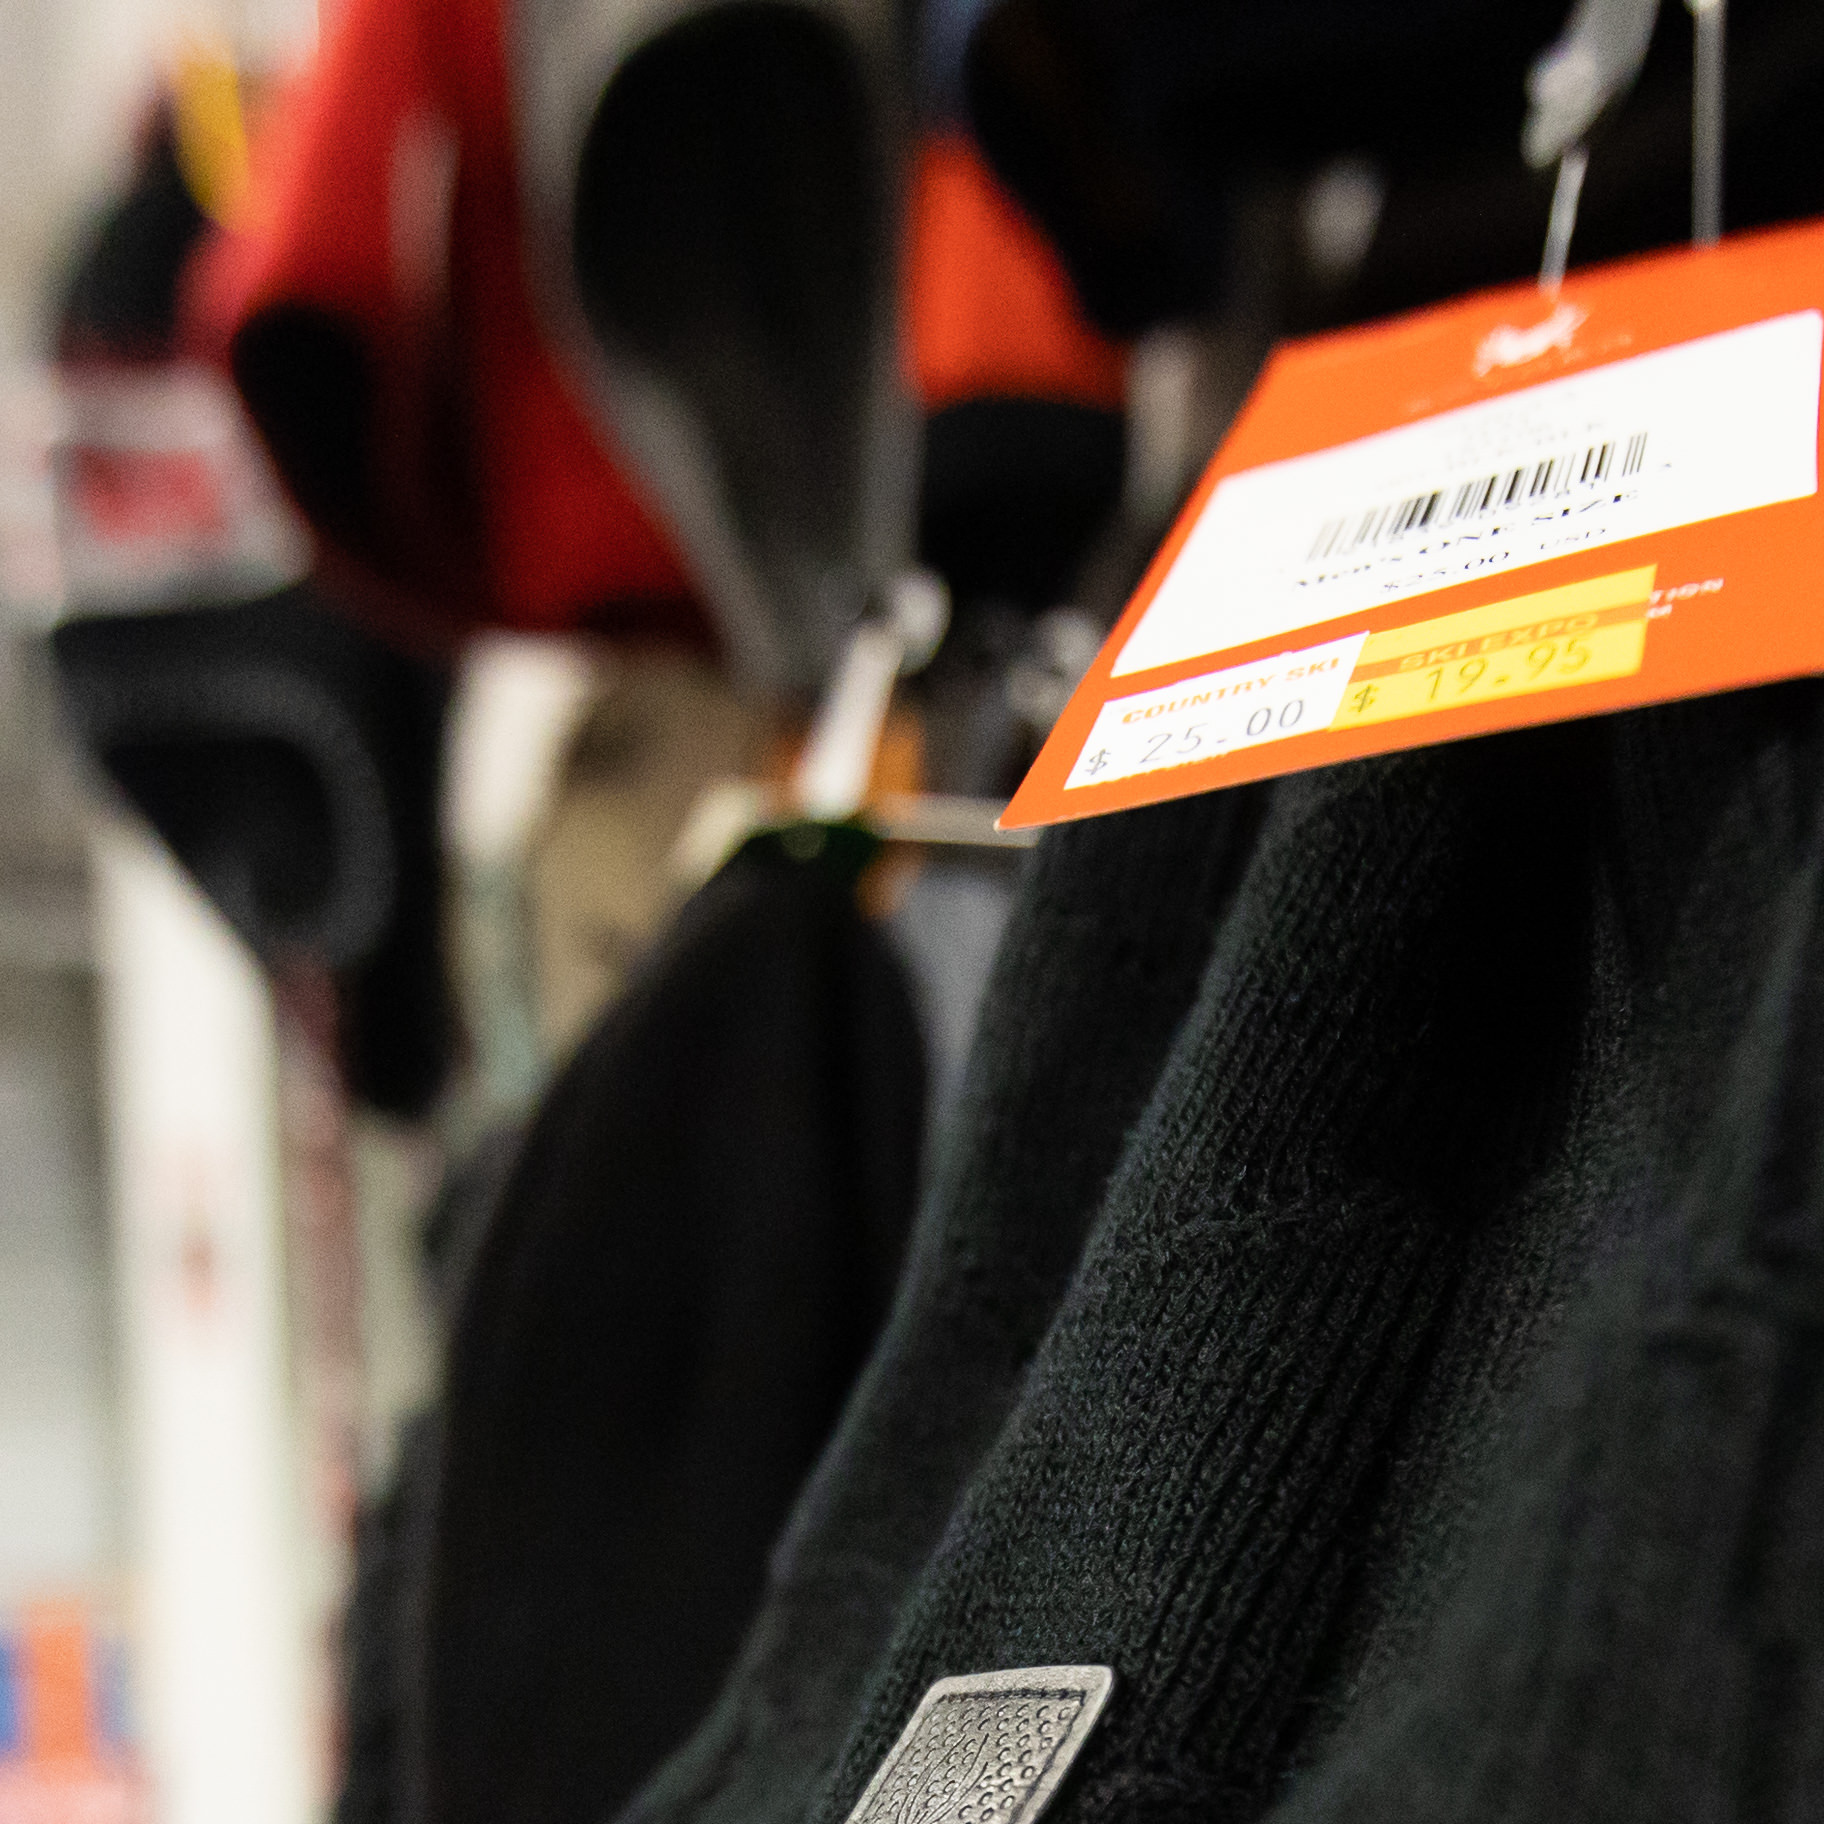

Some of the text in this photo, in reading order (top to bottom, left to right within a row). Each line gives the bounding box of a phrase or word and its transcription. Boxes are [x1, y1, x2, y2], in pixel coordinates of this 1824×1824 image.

[1417, 522, 1517, 556] ONE
[1529, 488, 1638, 526] SIZE
[1397, 612, 1600, 672] SKI EXPO
[1424, 637, 1590, 702] 19.95
[1121, 656, 1340, 725] COUNTRY SKI
[1138, 699, 1305, 764] 25.00
